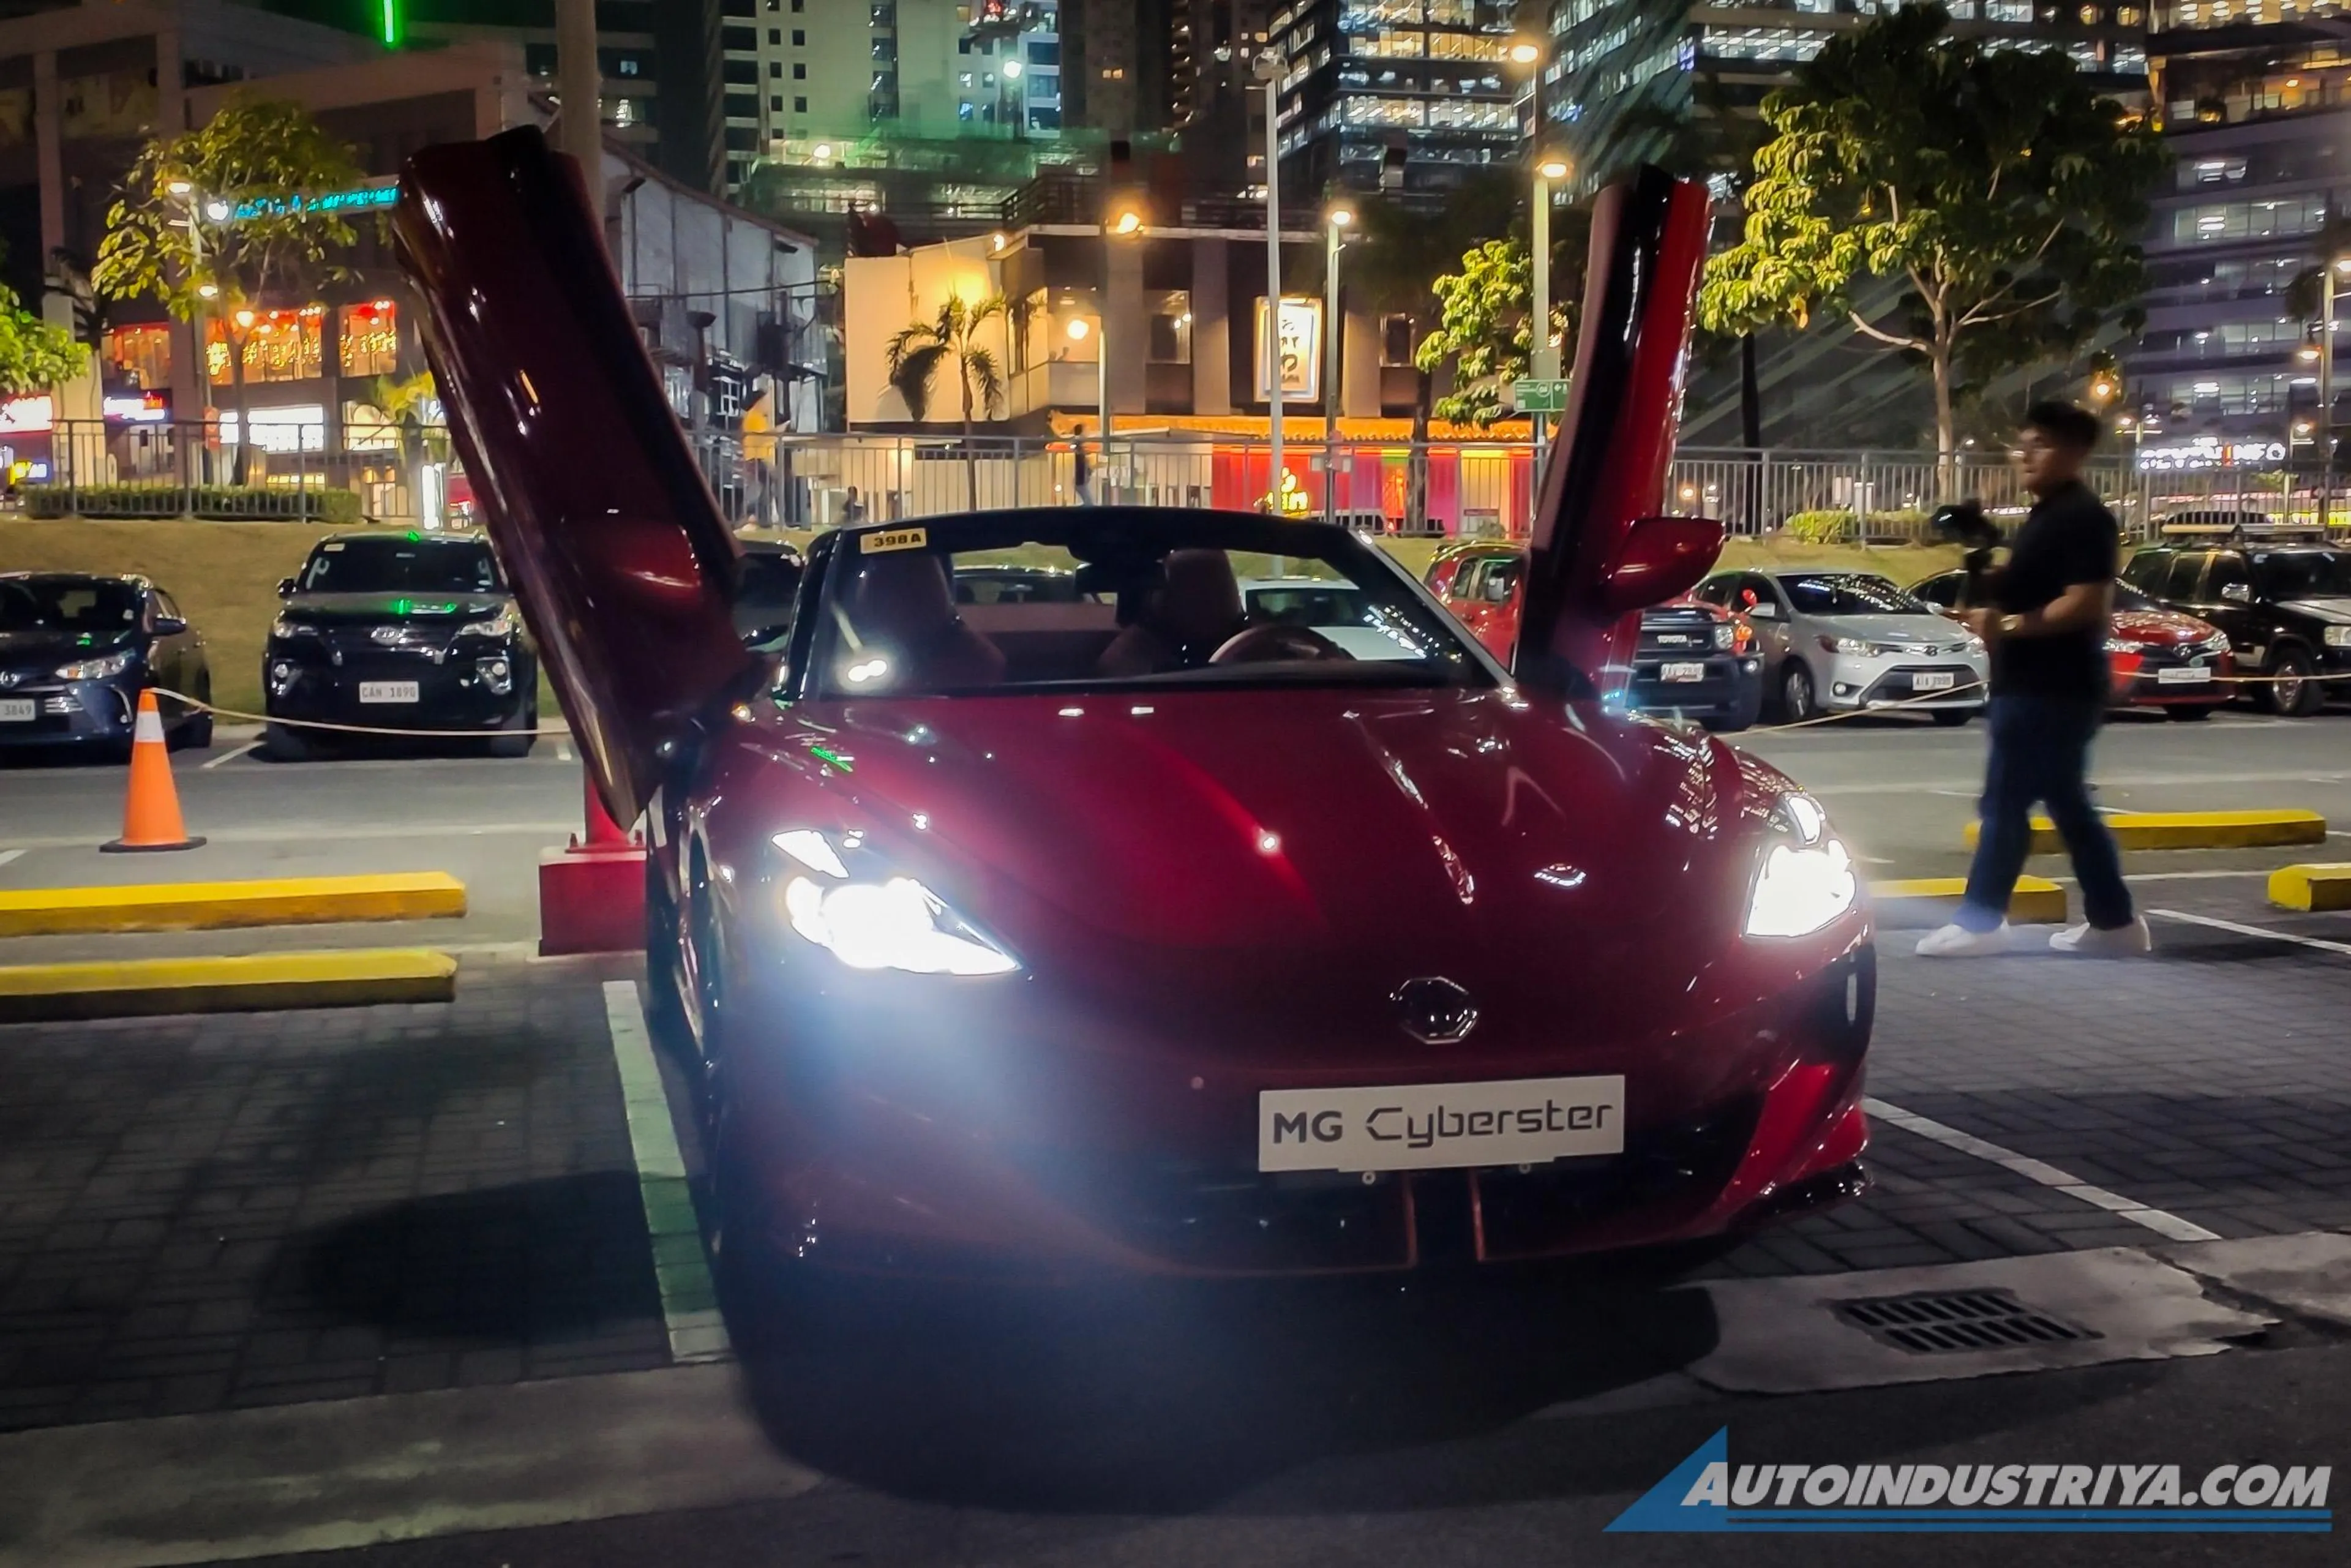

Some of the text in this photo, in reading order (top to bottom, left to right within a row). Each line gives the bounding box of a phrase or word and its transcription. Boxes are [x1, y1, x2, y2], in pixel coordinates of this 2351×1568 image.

[874, 533, 921, 547] 398A
[1273, 1100, 1613, 1148] MG Cyberster
